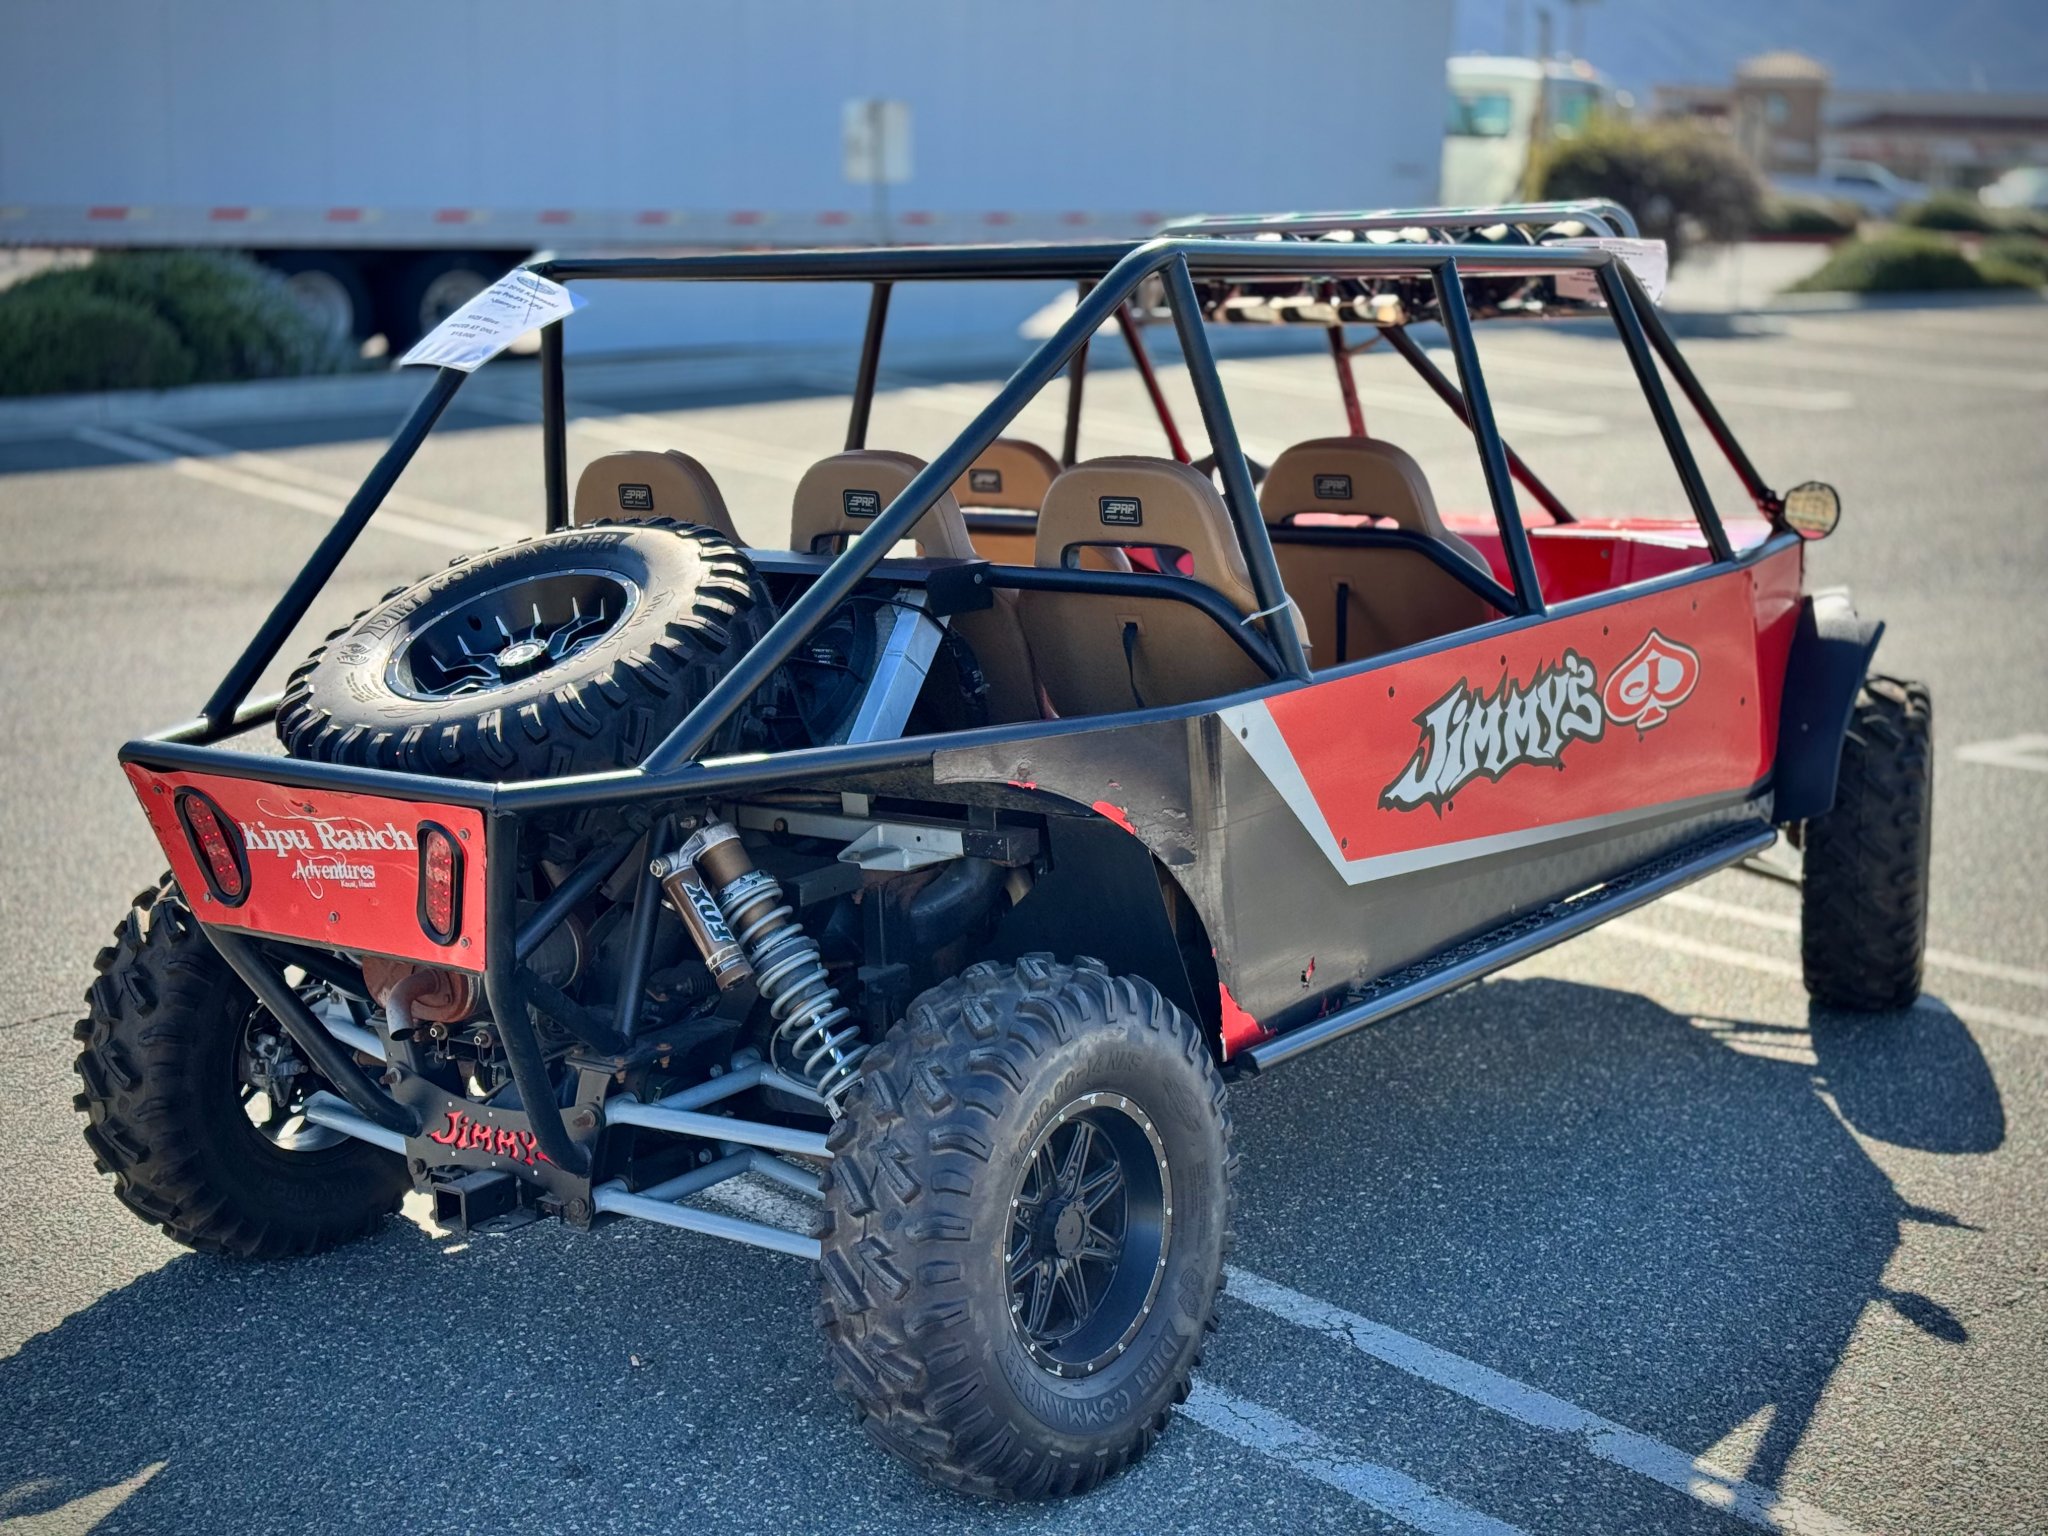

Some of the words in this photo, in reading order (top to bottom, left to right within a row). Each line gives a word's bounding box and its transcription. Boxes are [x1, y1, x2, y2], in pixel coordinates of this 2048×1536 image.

[480, 326, 500, 335] ONLY
[848, 496, 875, 507] PRP
[1104, 503, 1135, 515] PRP
[368, 595, 423, 632] DIRT
[313, 821, 417, 851] Ranch
[294, 859, 376, 880] Adventures
[1134, 1334, 1180, 1397] DIRT
[1005, 1347, 1131, 1428] COMMANDER
